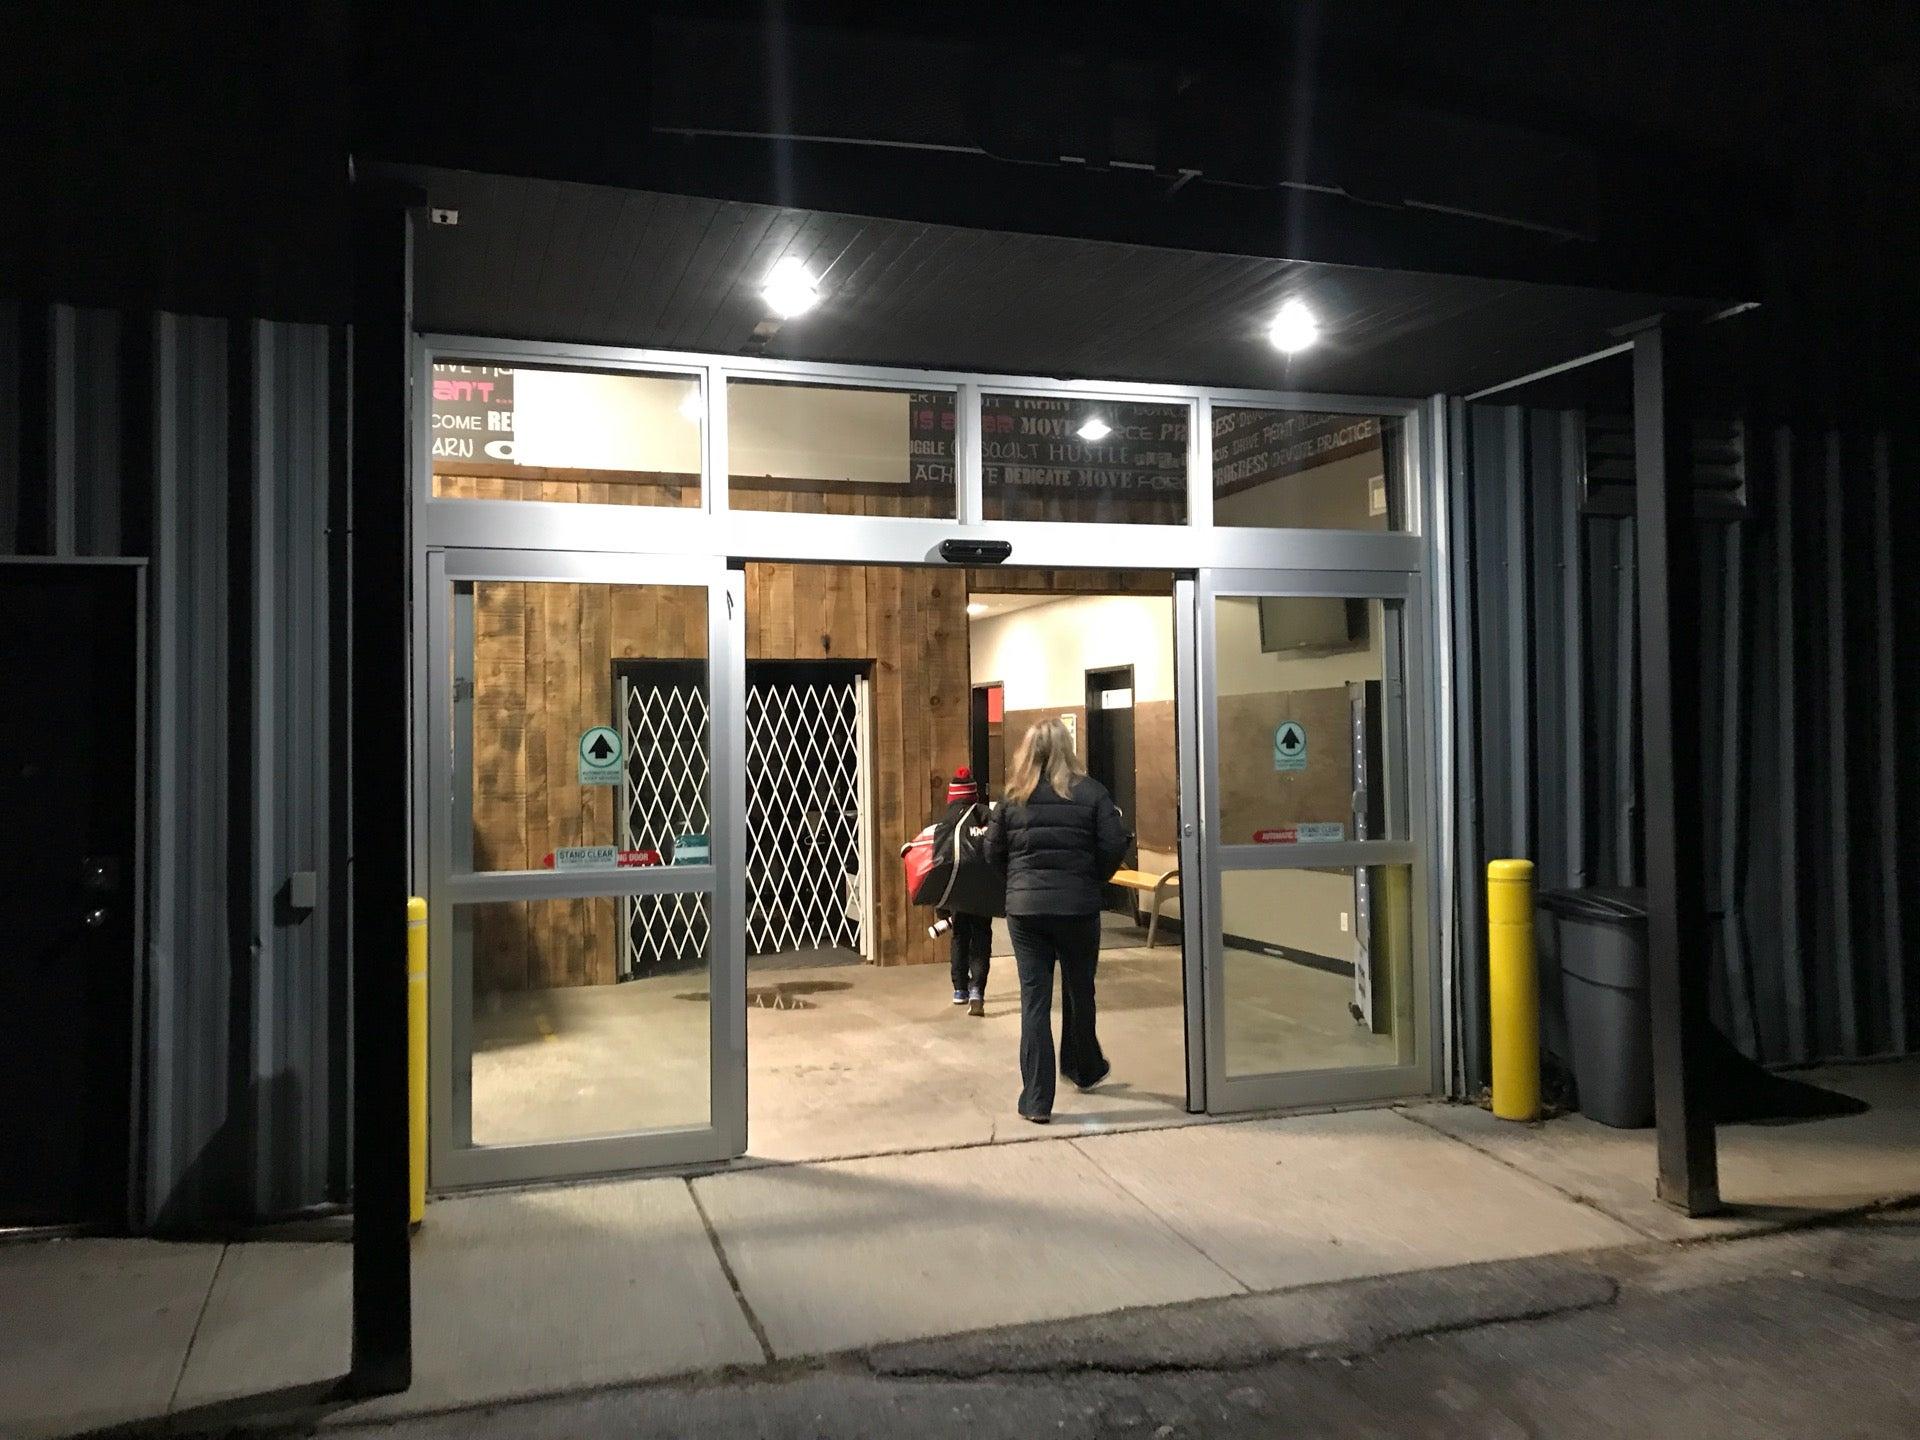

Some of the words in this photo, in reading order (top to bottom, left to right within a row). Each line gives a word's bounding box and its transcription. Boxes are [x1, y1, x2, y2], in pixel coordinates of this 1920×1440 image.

[487, 410, 514, 432] RE
[1317, 419, 1373, 452] PRACTICE
[1004, 466, 1072, 487] DEDICATE
[1077, 470, 1134, 489] MOVE
[559, 850, 586, 860] STAND
[587, 848, 613, 859] CLEAR
